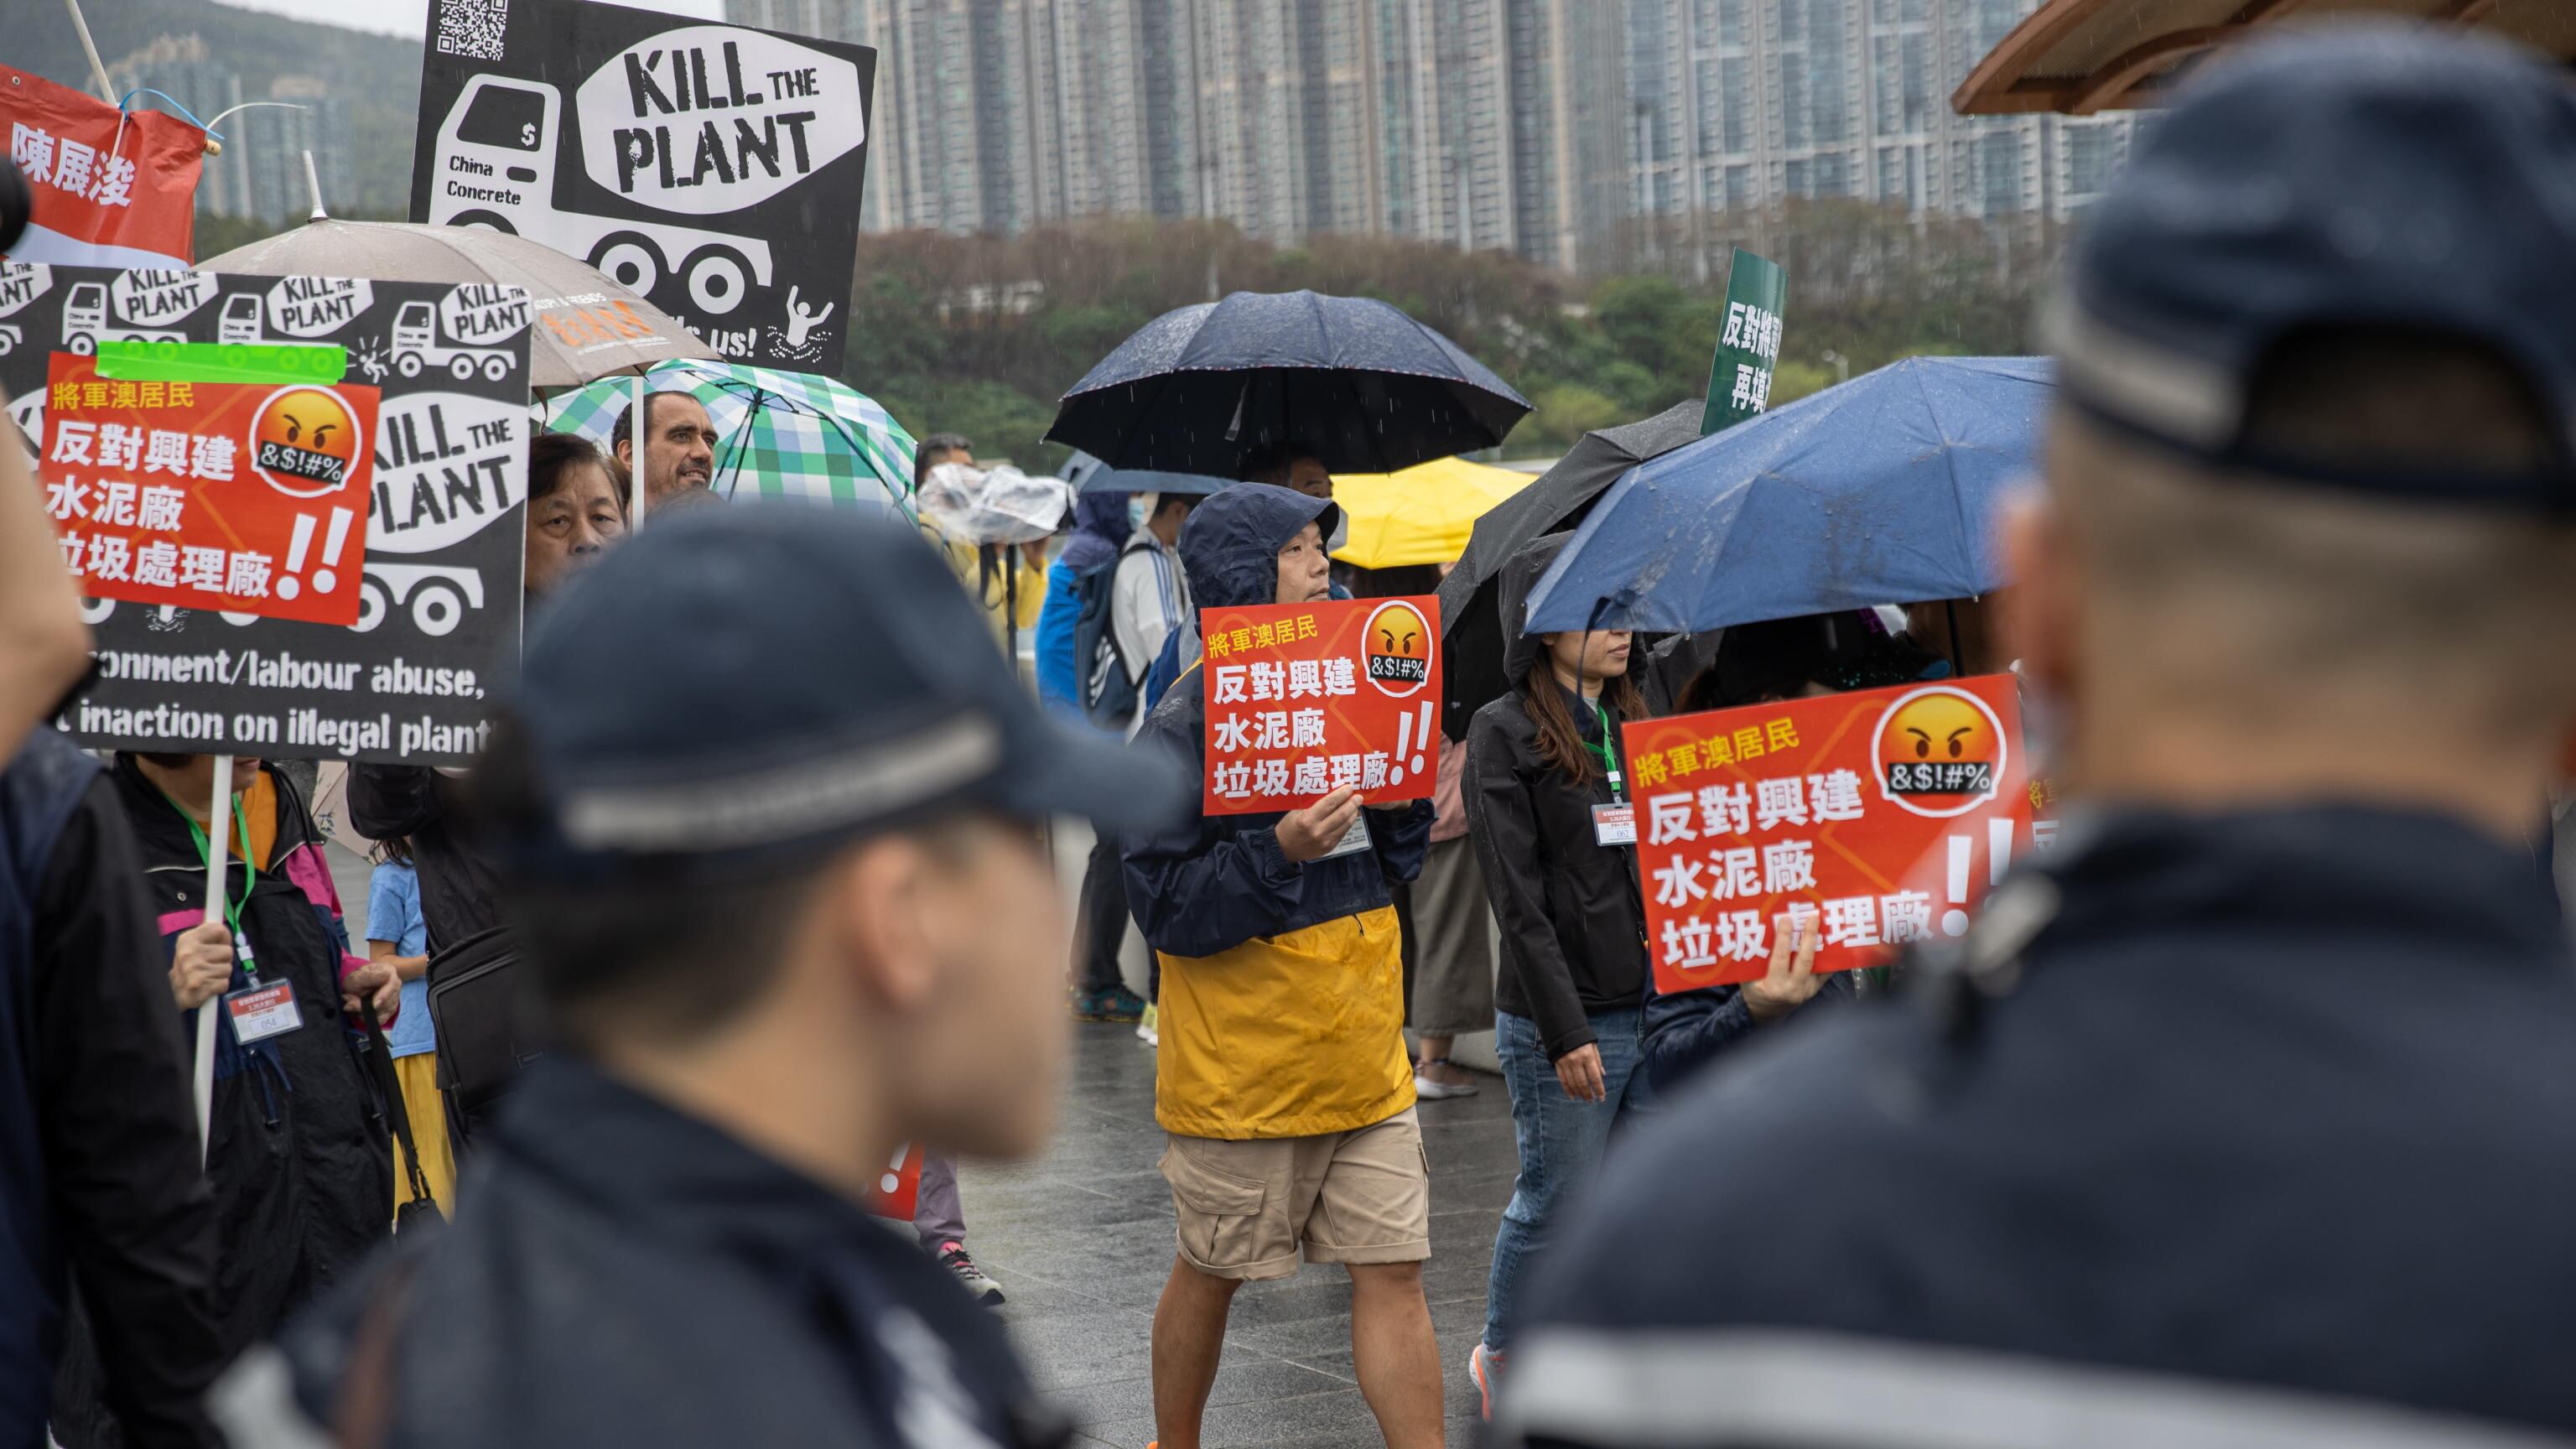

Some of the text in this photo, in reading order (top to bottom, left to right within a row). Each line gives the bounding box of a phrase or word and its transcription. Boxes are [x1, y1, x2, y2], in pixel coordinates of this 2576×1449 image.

[624, 42, 819, 117] KILL THE
[12, 122, 136, 207] 陳展浚
[449, 155, 493, 176] China
[613, 112, 816, 193] PLANT
[447, 180, 521, 205] Concrete
[126, 283, 200, 320] PLANT
[127, 269, 179, 293] KILL
[283, 278, 356, 304] KILL THE
[457, 284, 507, 311] KILL
[281, 294, 355, 332] PLANT
[454, 302, 528, 340] PLANT
[1722, 301, 1783, 363] 反對將軍
[53, 382, 195, 410] 將軍澳居民
[1732, 363, 1771, 413] 再填
[50, 419, 237, 482] 反對興建
[467, 418, 513, 449] THE
[44, 475, 184, 532] 水泥廠
[369, 455, 512, 534] LANT
[1208, 614, 1318, 659] 將軍澳居民
[87, 649, 485, 700] onment/labour abuse,
[1213, 657, 1356, 704] 反對興建
[1371, 655, 1425, 679] &$!#%
[80, 698, 223, 740] inaction
[233, 714, 278, 744] on
[288, 708, 390, 756] illegal
[1213, 708, 1327, 753] 水泥廠
[1633, 717, 1800, 788] 將軍澳居民
[1889, 763, 1990, 791] &$!#%
[1648, 768, 1865, 847] 反對興建
[1617, 829, 1629, 839] 062
[1653, 839, 1818, 909] 水泥廠
[261, 1017, 276, 1031] 054
